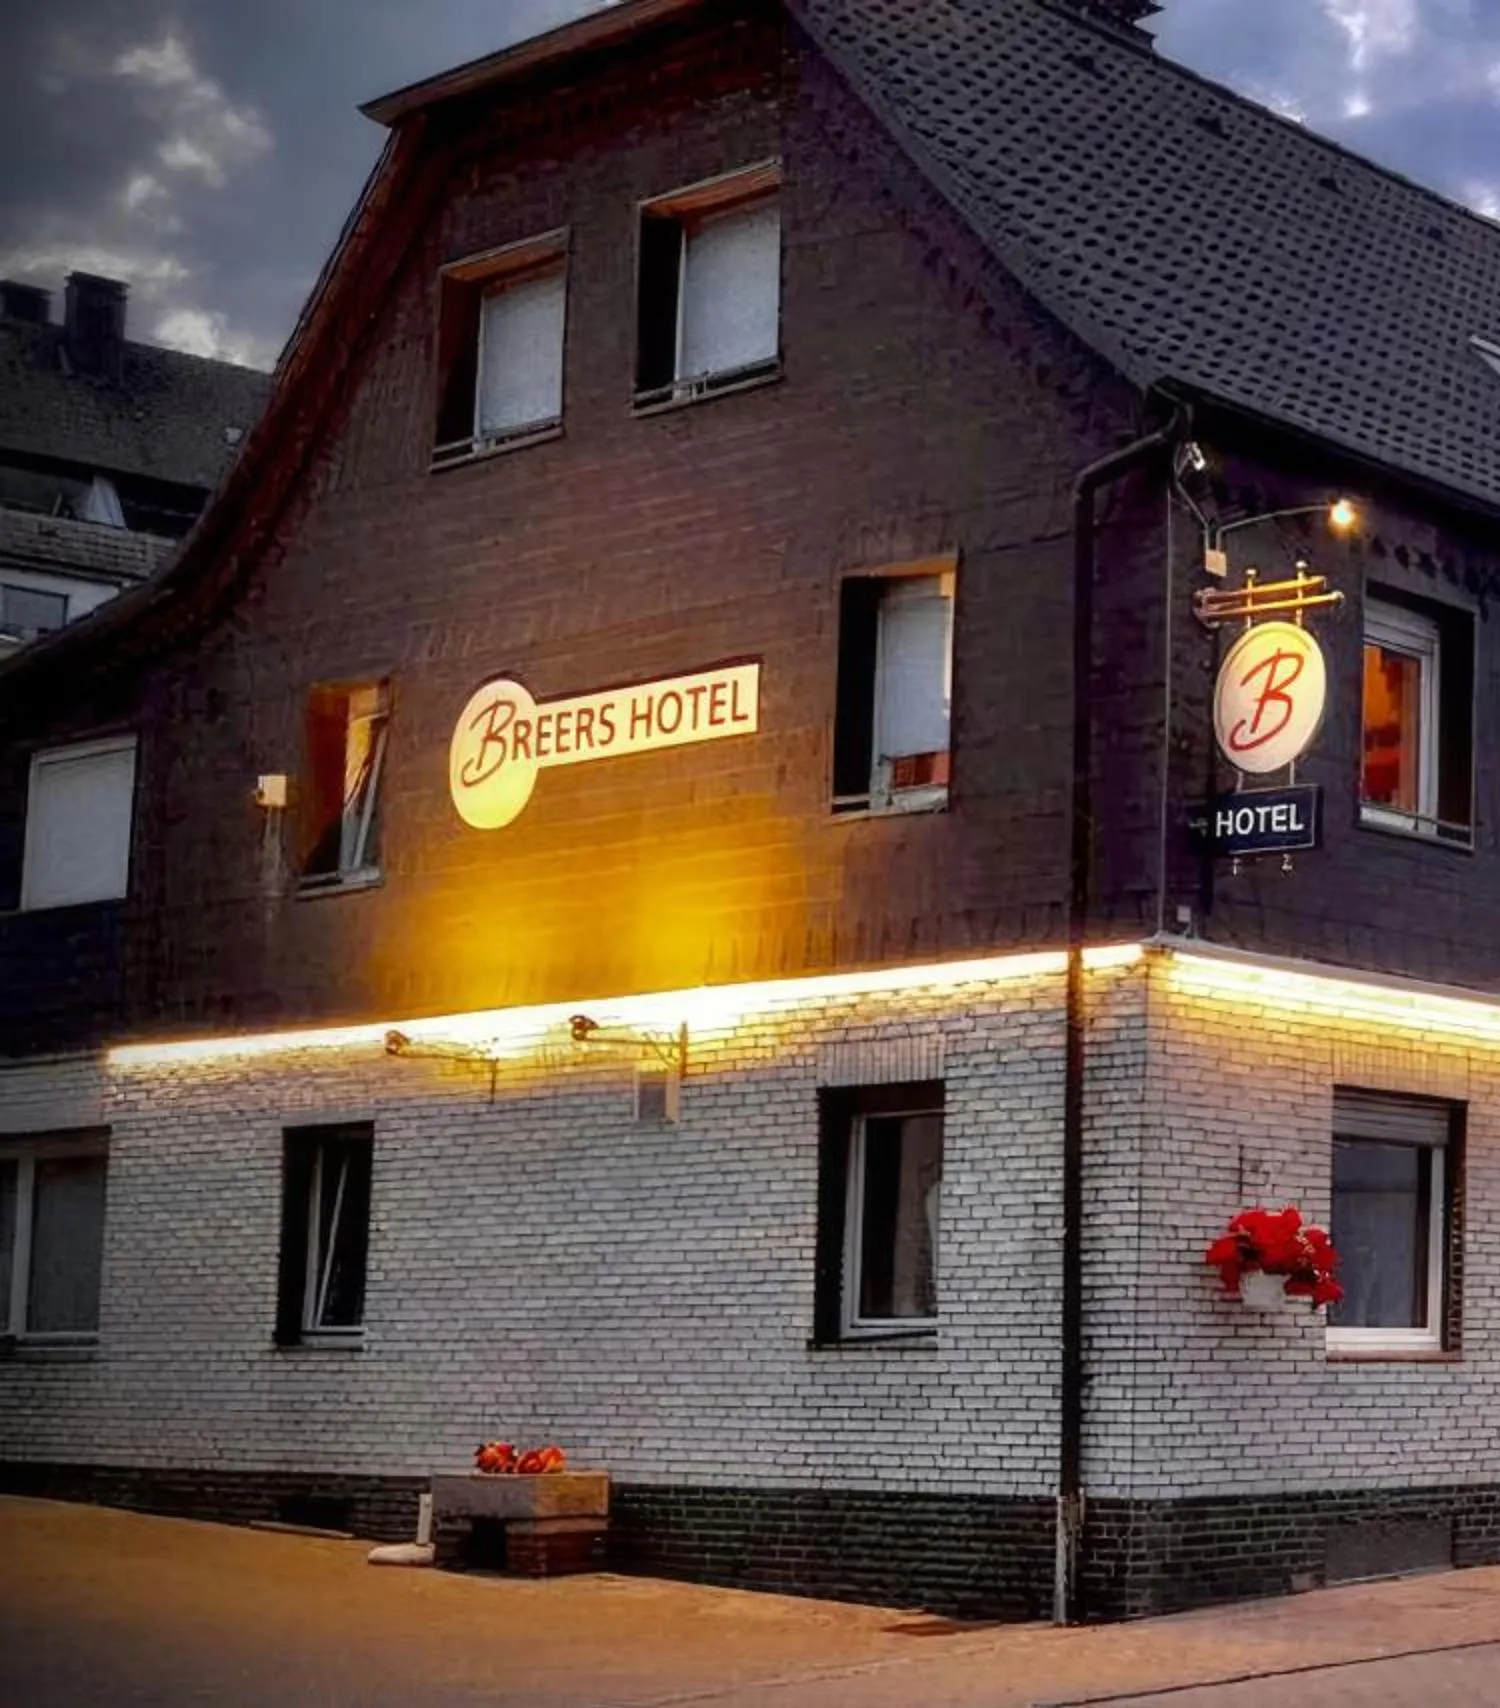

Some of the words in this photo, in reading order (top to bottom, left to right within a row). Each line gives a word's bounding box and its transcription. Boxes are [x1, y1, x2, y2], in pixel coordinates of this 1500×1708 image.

[461, 699, 616, 788] BREERS
[629, 679, 749, 741] HOTEL
[1229, 648, 1305, 752] B
[1215, 803, 1305, 838] HOTEL
